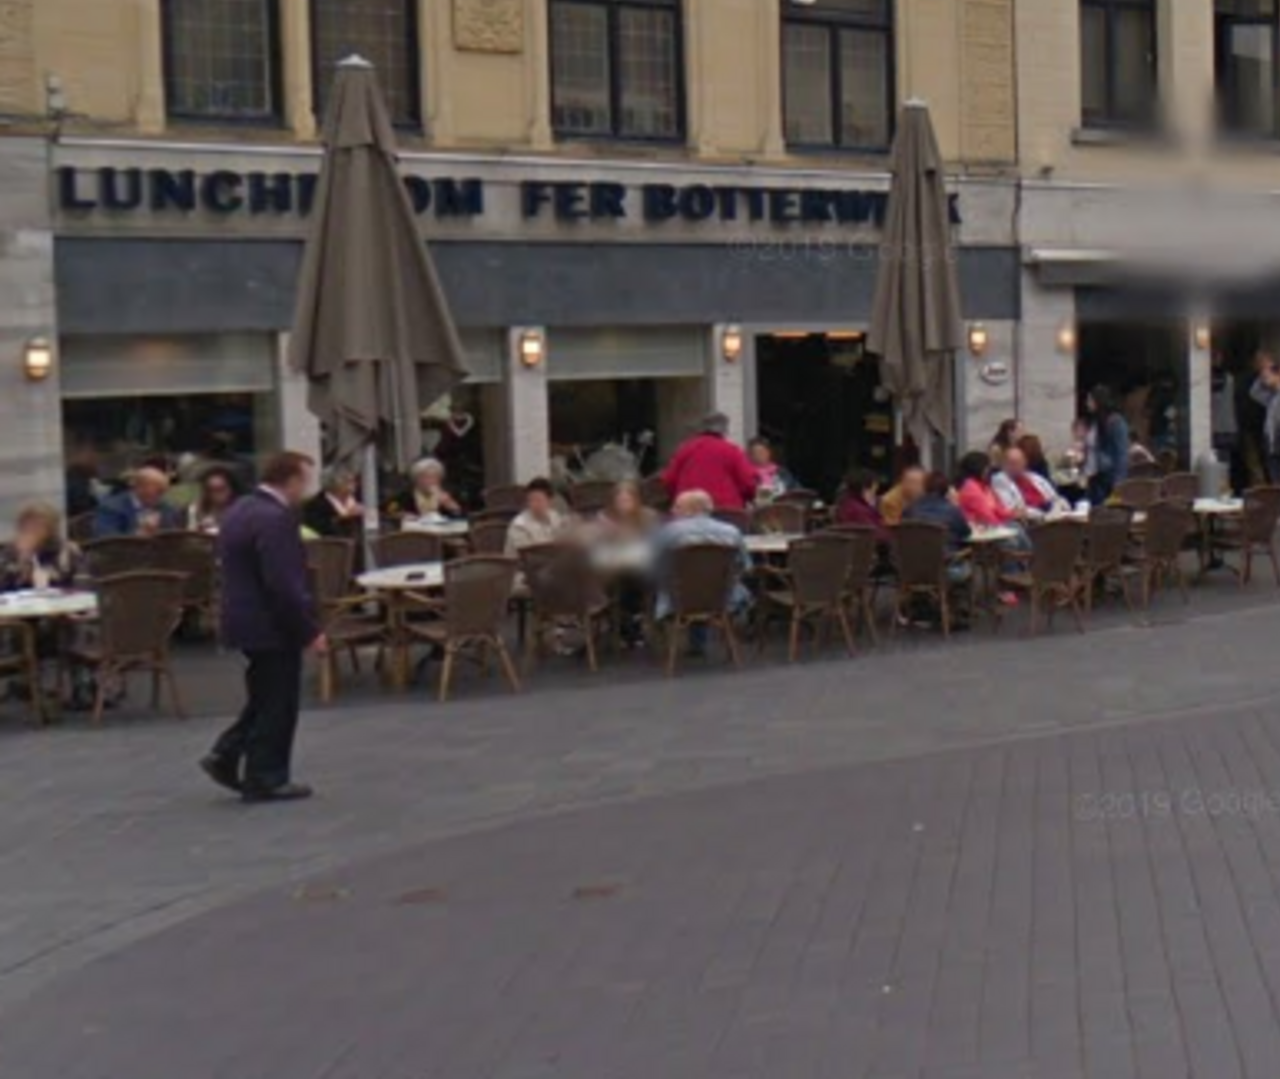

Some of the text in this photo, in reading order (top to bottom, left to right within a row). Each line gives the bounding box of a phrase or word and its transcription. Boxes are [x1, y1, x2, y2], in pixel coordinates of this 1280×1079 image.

[57, 163, 964, 225] LUNCHOM FER BOTTERW
